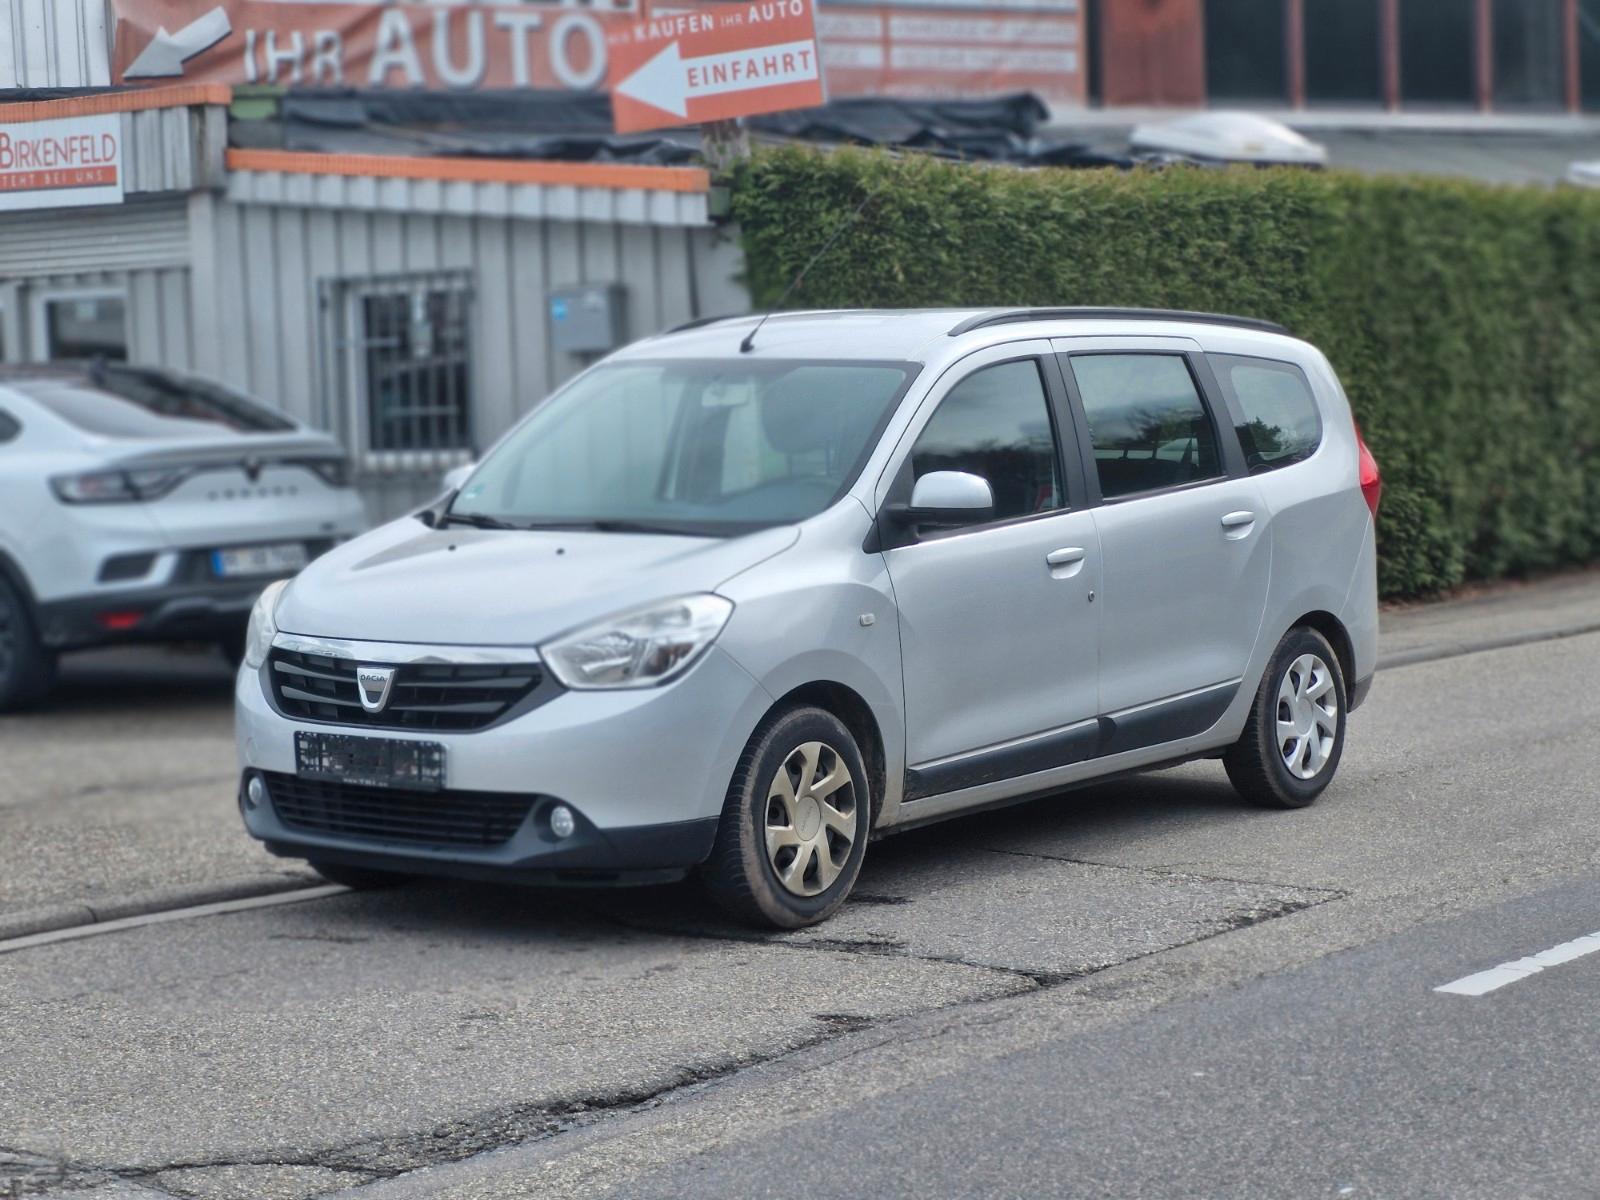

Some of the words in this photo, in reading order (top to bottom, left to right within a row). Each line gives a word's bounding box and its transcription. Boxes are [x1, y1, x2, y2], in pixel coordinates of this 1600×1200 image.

[634, 13, 714, 42] KAUFEN
[720, 13, 743, 27] IHR
[748, 0, 803, 23] AUTO
[244, 29, 344, 85] IHR
[367, 7, 609, 89] AUTO
[687, 50, 811, 87] EINFAHRT
